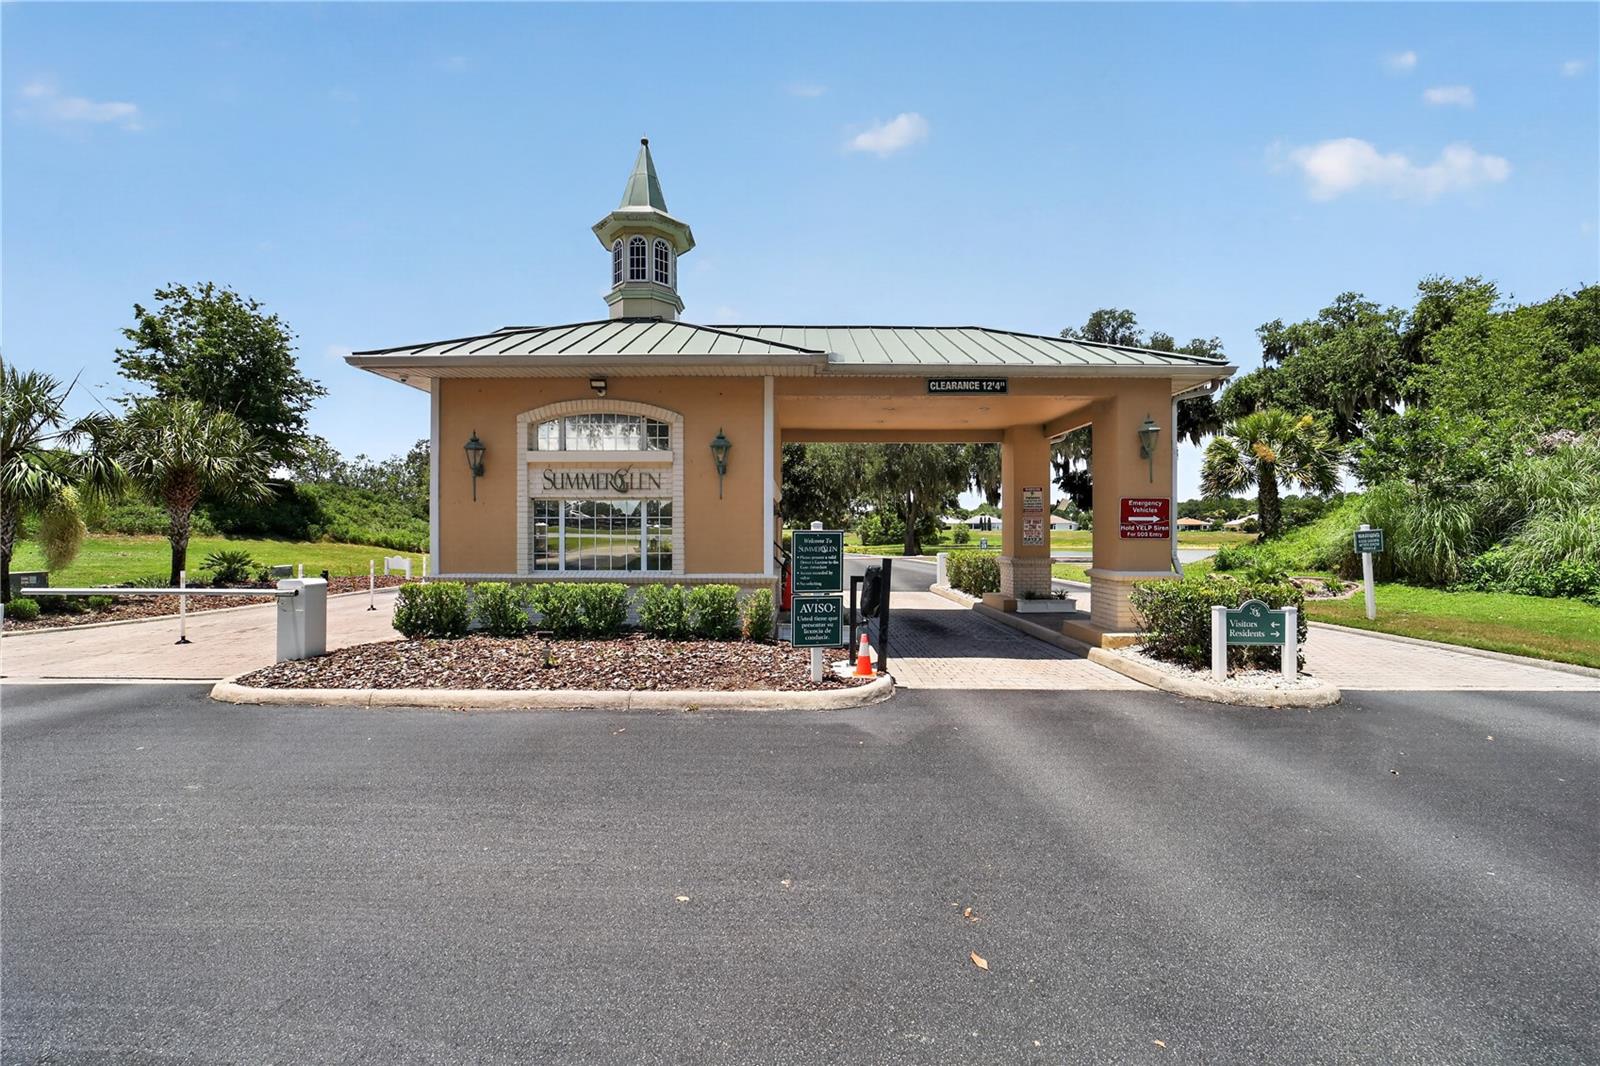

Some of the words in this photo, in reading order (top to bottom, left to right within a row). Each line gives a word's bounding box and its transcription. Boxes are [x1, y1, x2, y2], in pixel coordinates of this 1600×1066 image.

[930, 381, 980, 390] CLEARANCE
[982, 381, 1005, 390] 12'4"
[800, 603, 836, 613] AVISO:
[1229, 629, 1265, 637] Residents
